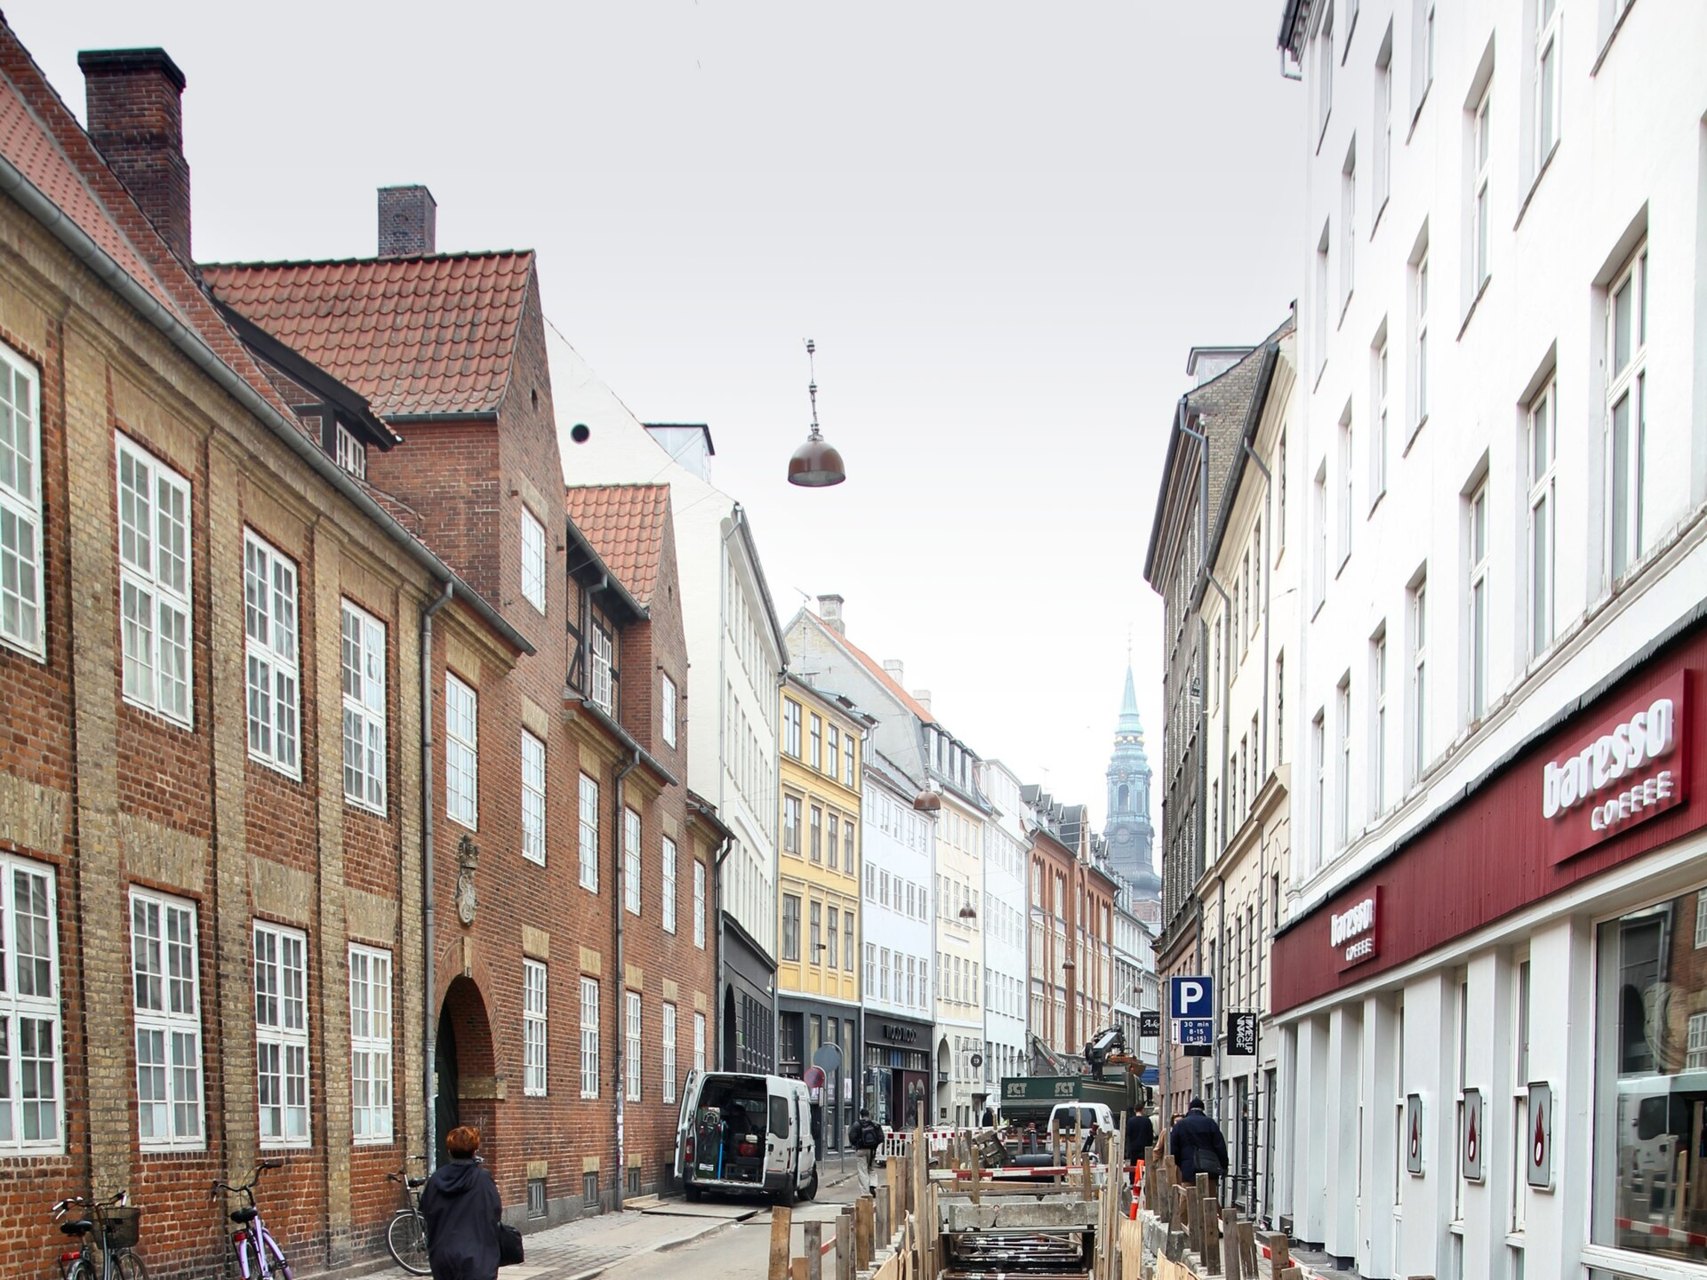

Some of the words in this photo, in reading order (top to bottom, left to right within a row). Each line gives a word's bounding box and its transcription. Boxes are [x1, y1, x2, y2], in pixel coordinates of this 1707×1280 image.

[1543, 698, 1673, 819] baresso
[1591, 771, 1673, 831] COFFEE
[1181, 982, 1203, 1013] P
[1244, 1042, 1254, 1053] UP
[1007, 1083, 1027, 1095] SCT
[1054, 1082, 1075, 1094] SCT
